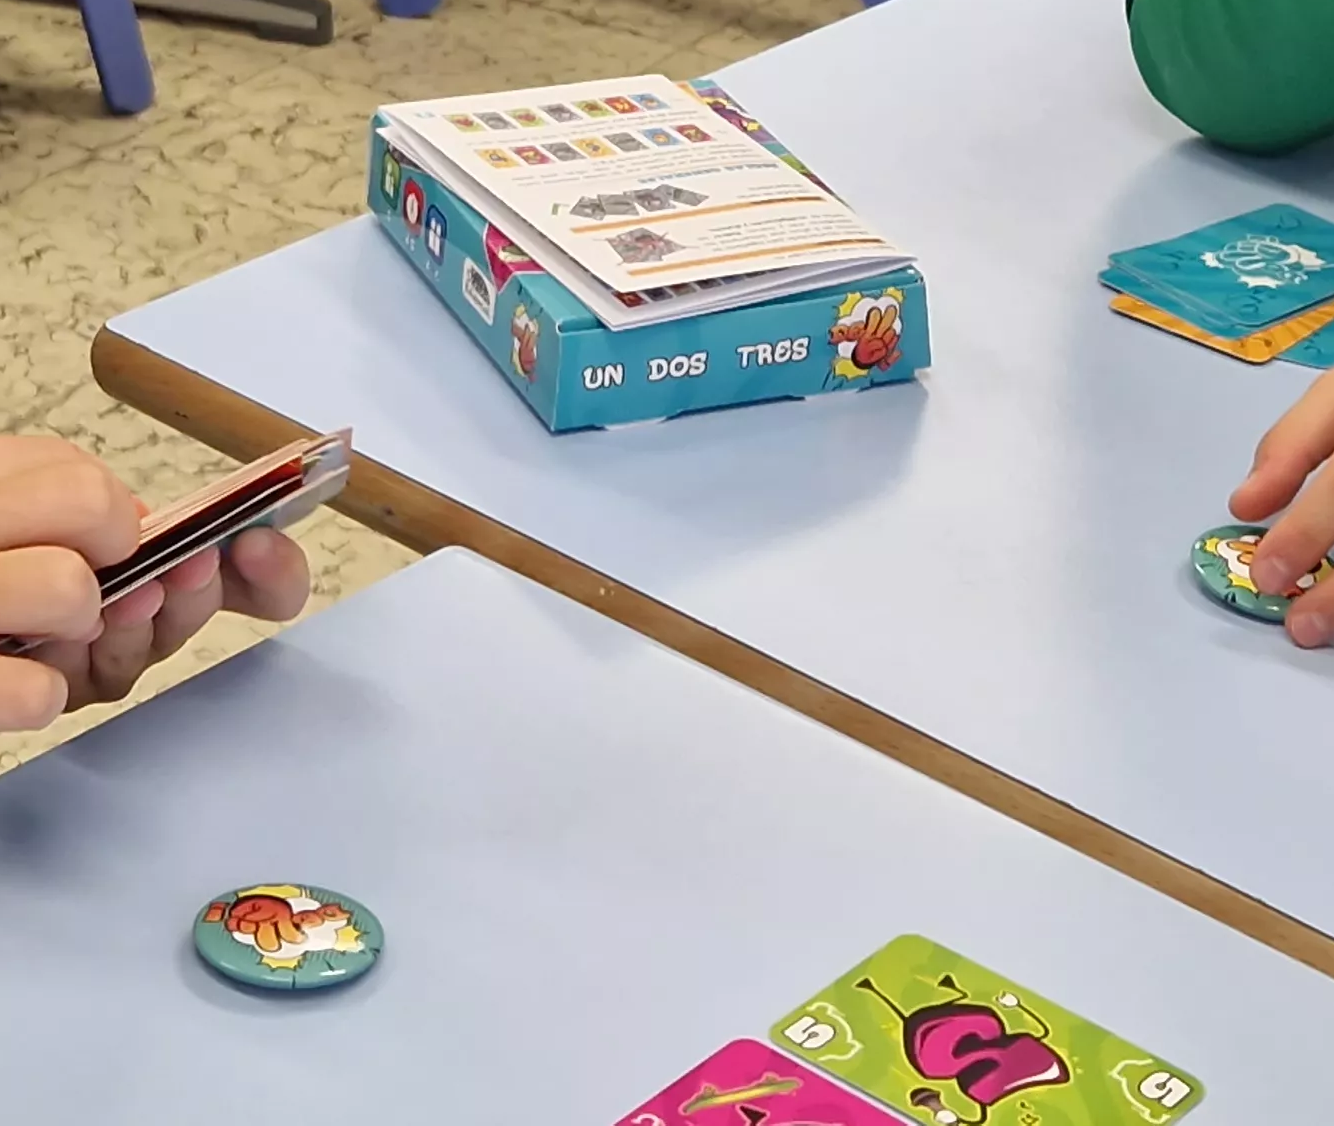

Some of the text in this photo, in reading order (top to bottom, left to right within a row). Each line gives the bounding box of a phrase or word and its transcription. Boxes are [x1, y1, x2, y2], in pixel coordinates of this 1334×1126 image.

[583, 336, 810, 390] UN DOS TRES
[781, 1015, 837, 1050] 5
[1138, 1071, 1192, 1109] 5
